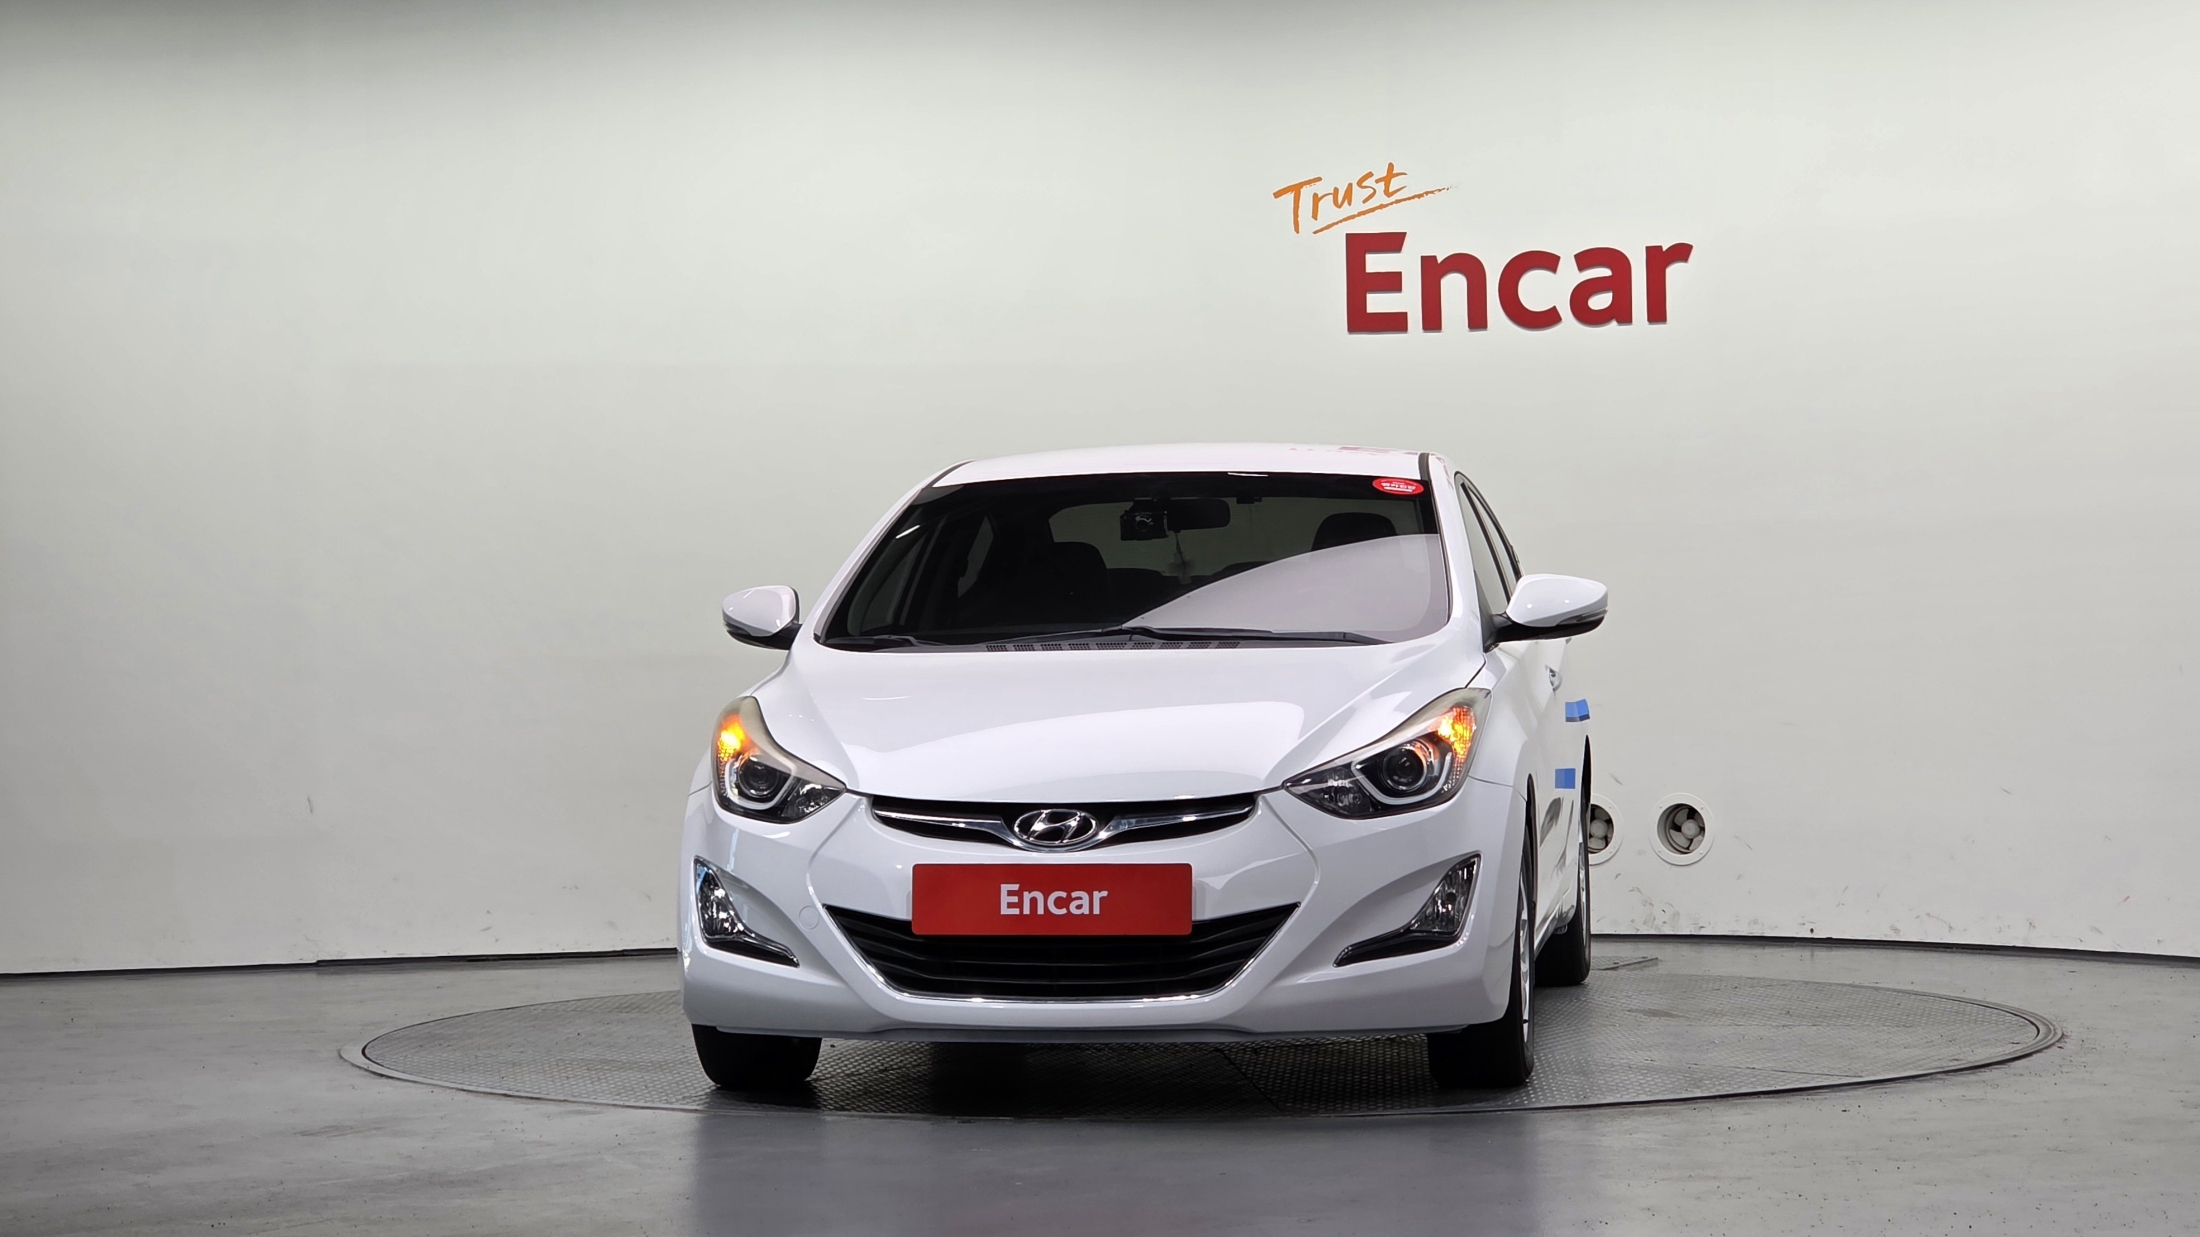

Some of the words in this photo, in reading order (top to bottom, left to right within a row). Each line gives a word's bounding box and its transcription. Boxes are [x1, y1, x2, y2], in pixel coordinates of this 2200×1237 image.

[1273, 162, 1408, 235] Trust
[1345, 231, 1694, 333] Encar
[1000, 883, 1108, 915] Encar
